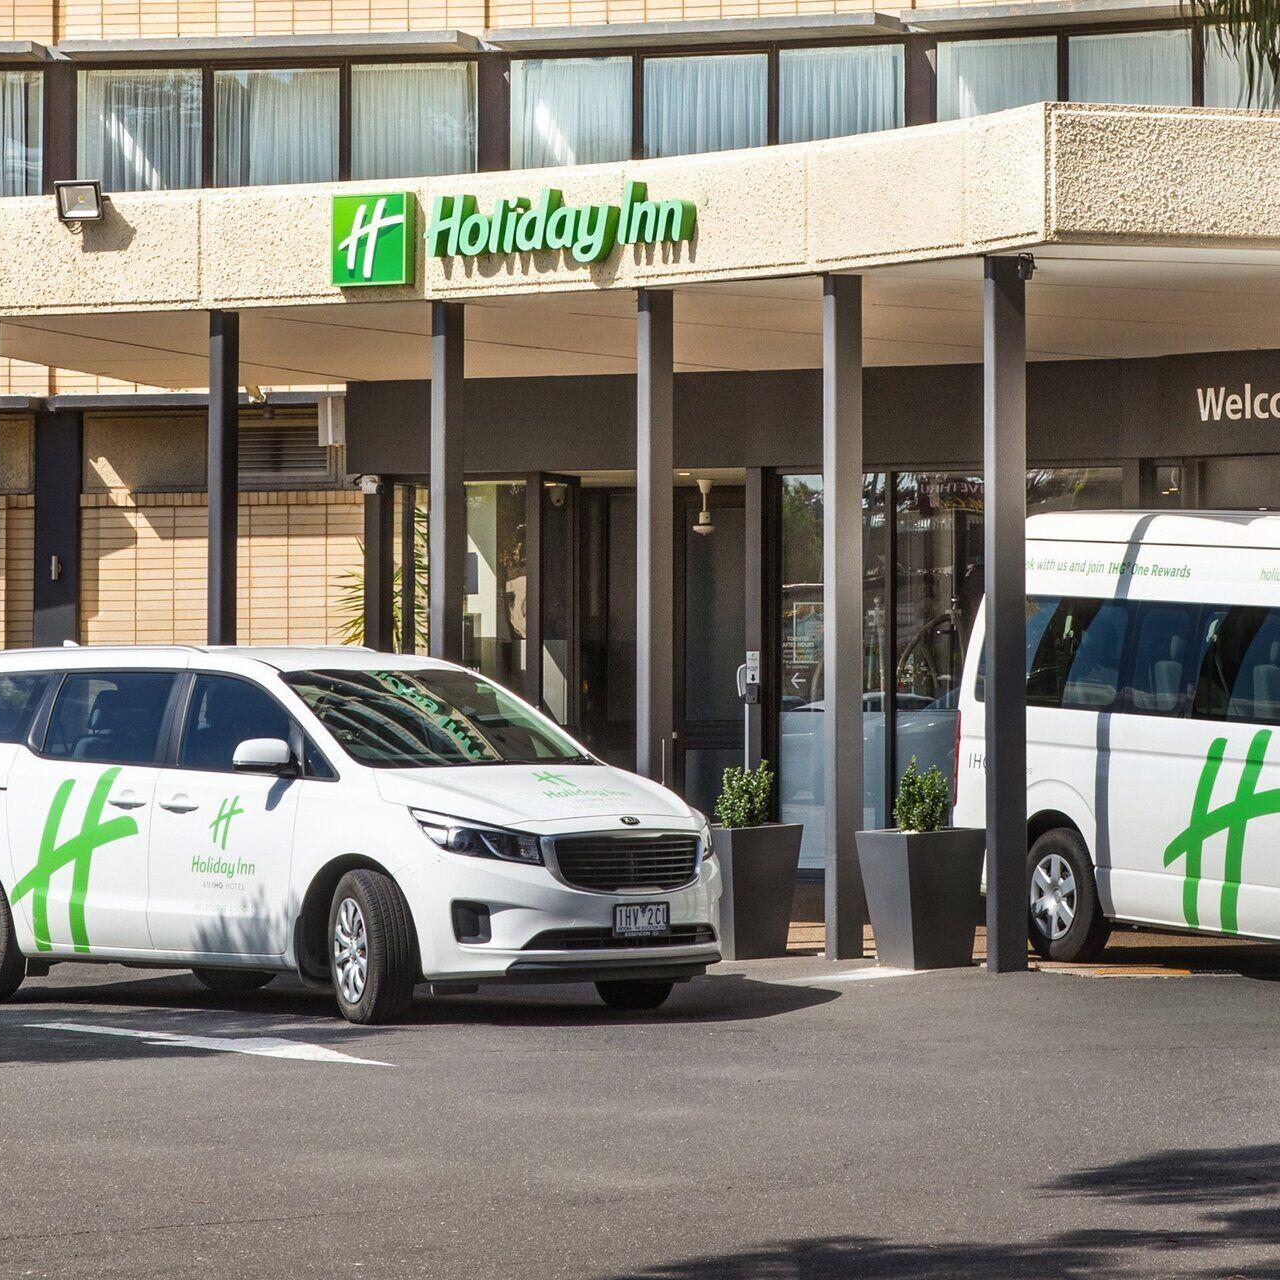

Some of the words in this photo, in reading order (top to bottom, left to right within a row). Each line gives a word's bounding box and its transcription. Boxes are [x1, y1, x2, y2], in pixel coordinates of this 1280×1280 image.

[424, 187, 616, 263] Holiday
[617, 180, 693, 246] Inn
[1036, 558, 1055, 571] with
[1057, 560, 1067, 571] us
[1069, 559, 1085, 572] and
[1086, 560, 1105, 576] join
[1131, 563, 1149, 575] One
[1151, 563, 1191, 578] Rewards
[969, 753, 987, 770] IH
[542, 788, 605, 799] Holiday
[191, 855, 235, 878] Holiday
[237, 857, 256, 875] Inn
